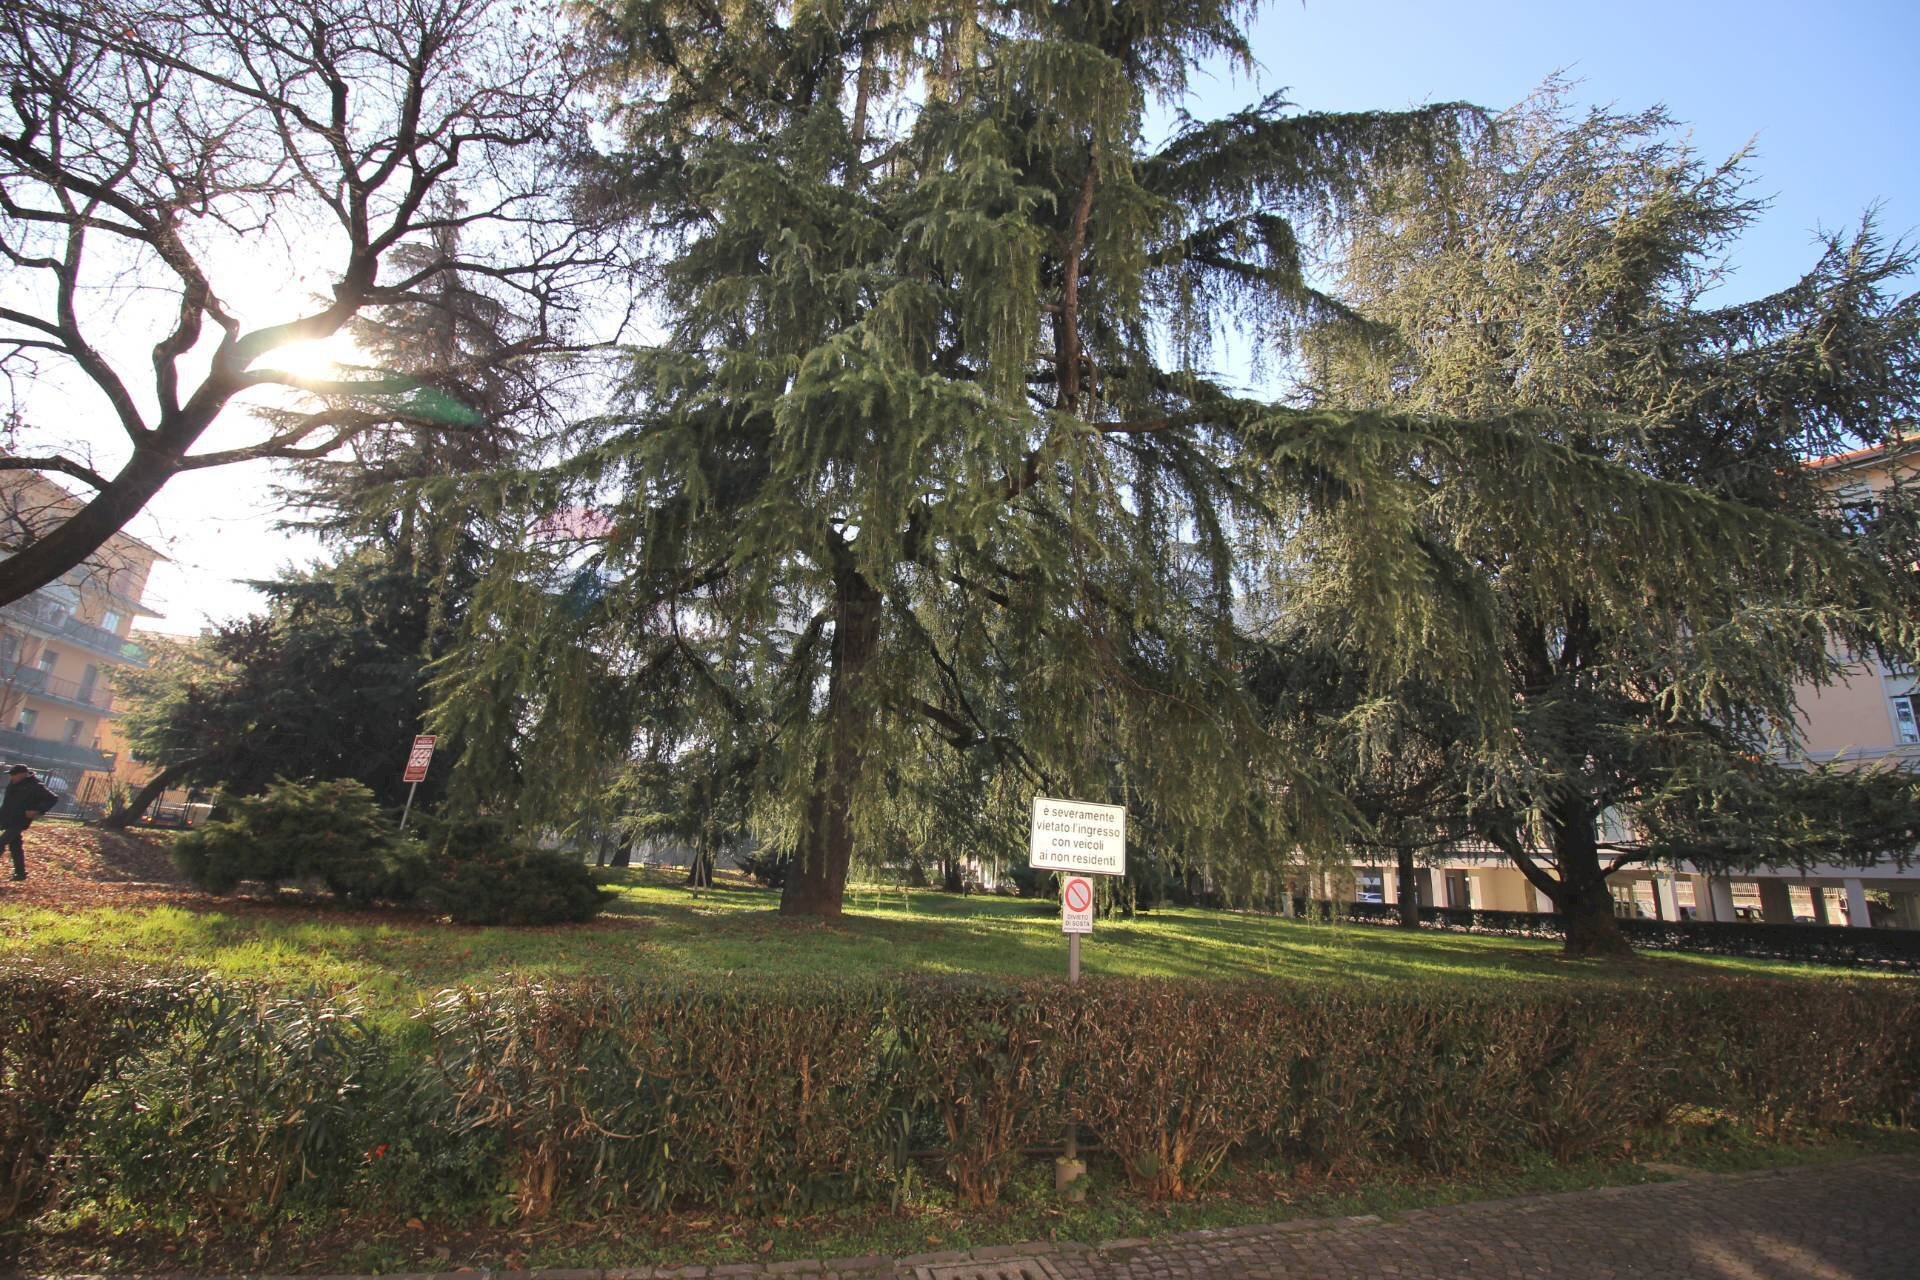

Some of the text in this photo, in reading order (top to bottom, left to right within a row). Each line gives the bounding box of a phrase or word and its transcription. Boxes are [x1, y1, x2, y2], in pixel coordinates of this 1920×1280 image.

[1052, 808, 1115, 823] severamente
[1036, 821, 1120, 837] vietato l'ingresso
[1052, 838, 1104, 851] con veicoli
[1039, 849, 1116, 866] ai non residenti
